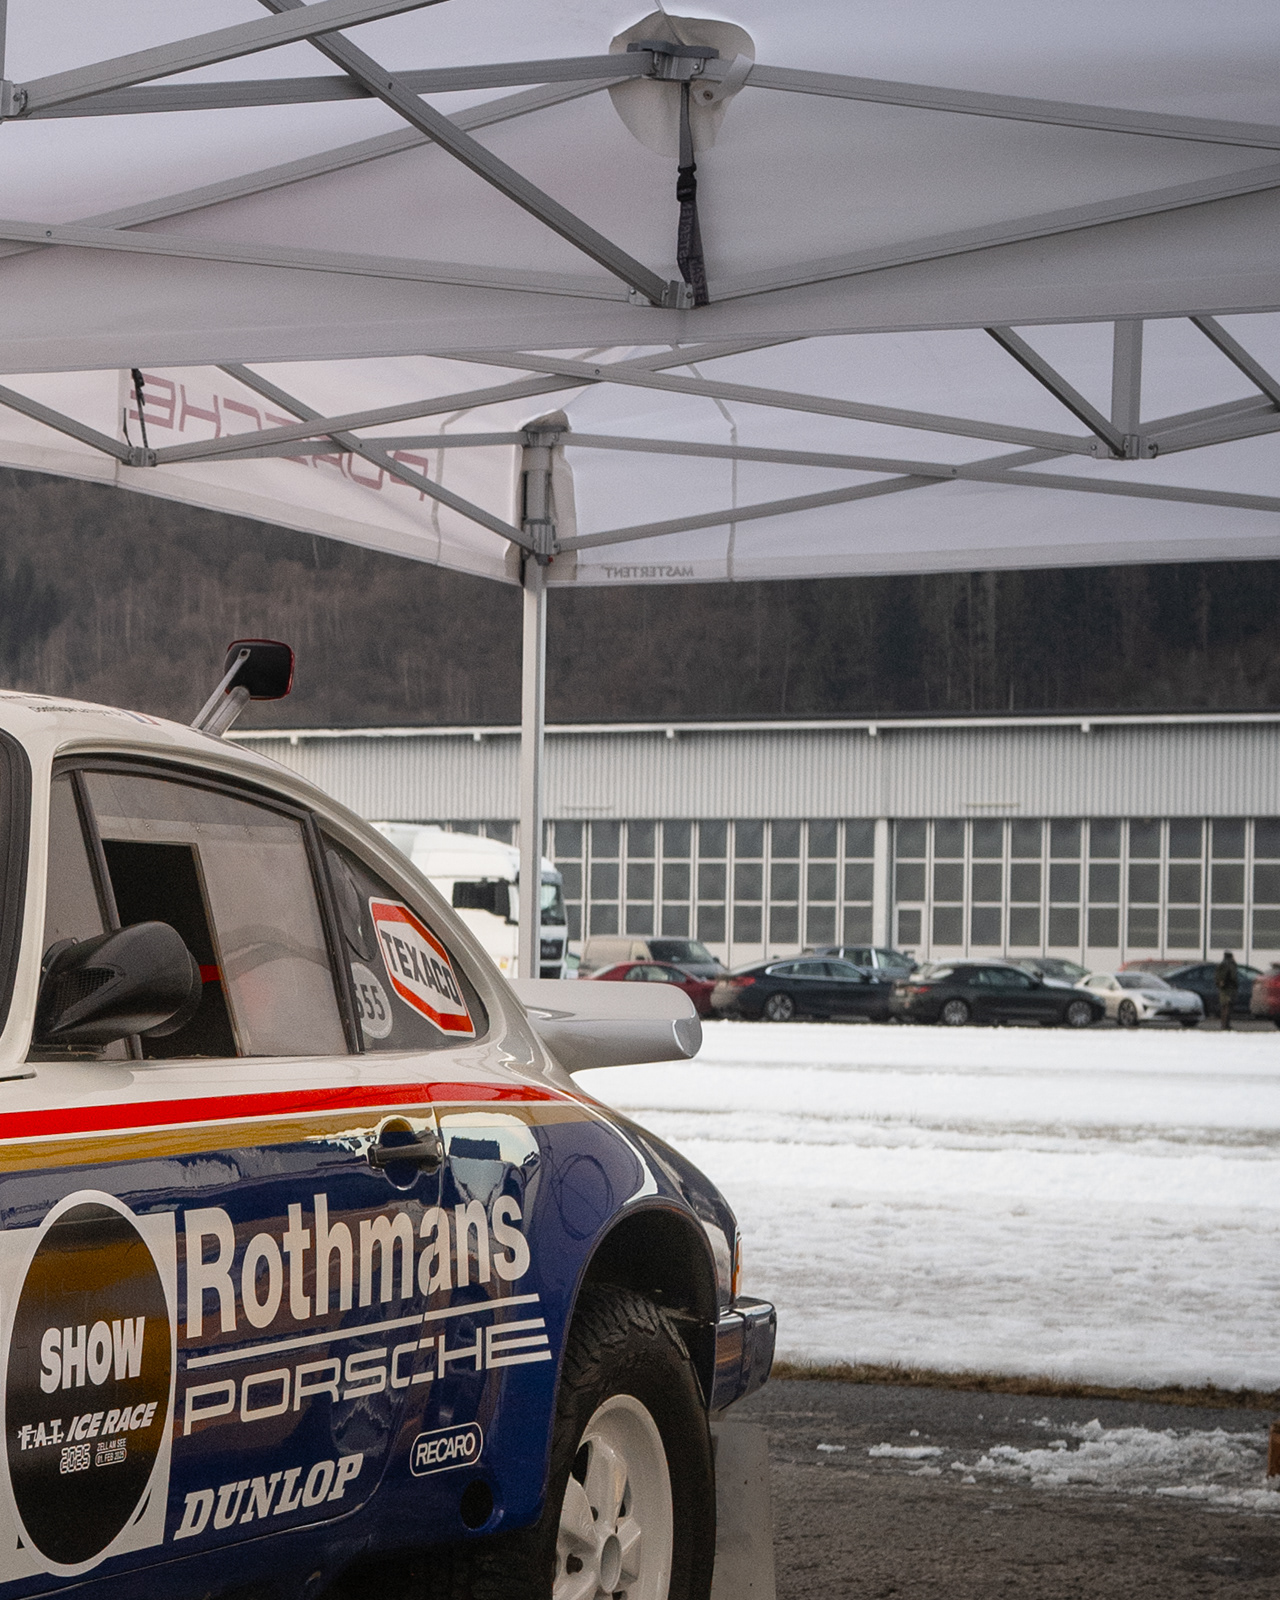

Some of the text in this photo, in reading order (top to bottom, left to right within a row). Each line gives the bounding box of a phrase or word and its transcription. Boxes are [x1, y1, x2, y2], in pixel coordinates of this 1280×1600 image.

[380, 928, 463, 1008] TEXACO
[184, 1193, 531, 1339] Rothmans
[40, 1316, 146, 1394] SHOW
[182, 1317, 552, 1436] PORSCHE
[66, 1411, 104, 1442] ICE
[101, 1401, 159, 1436] RACE
[117, 1437, 127, 1448] SEE
[415, 1432, 477, 1467] RECARO
[173, 1453, 363, 1541] DUNLOP
